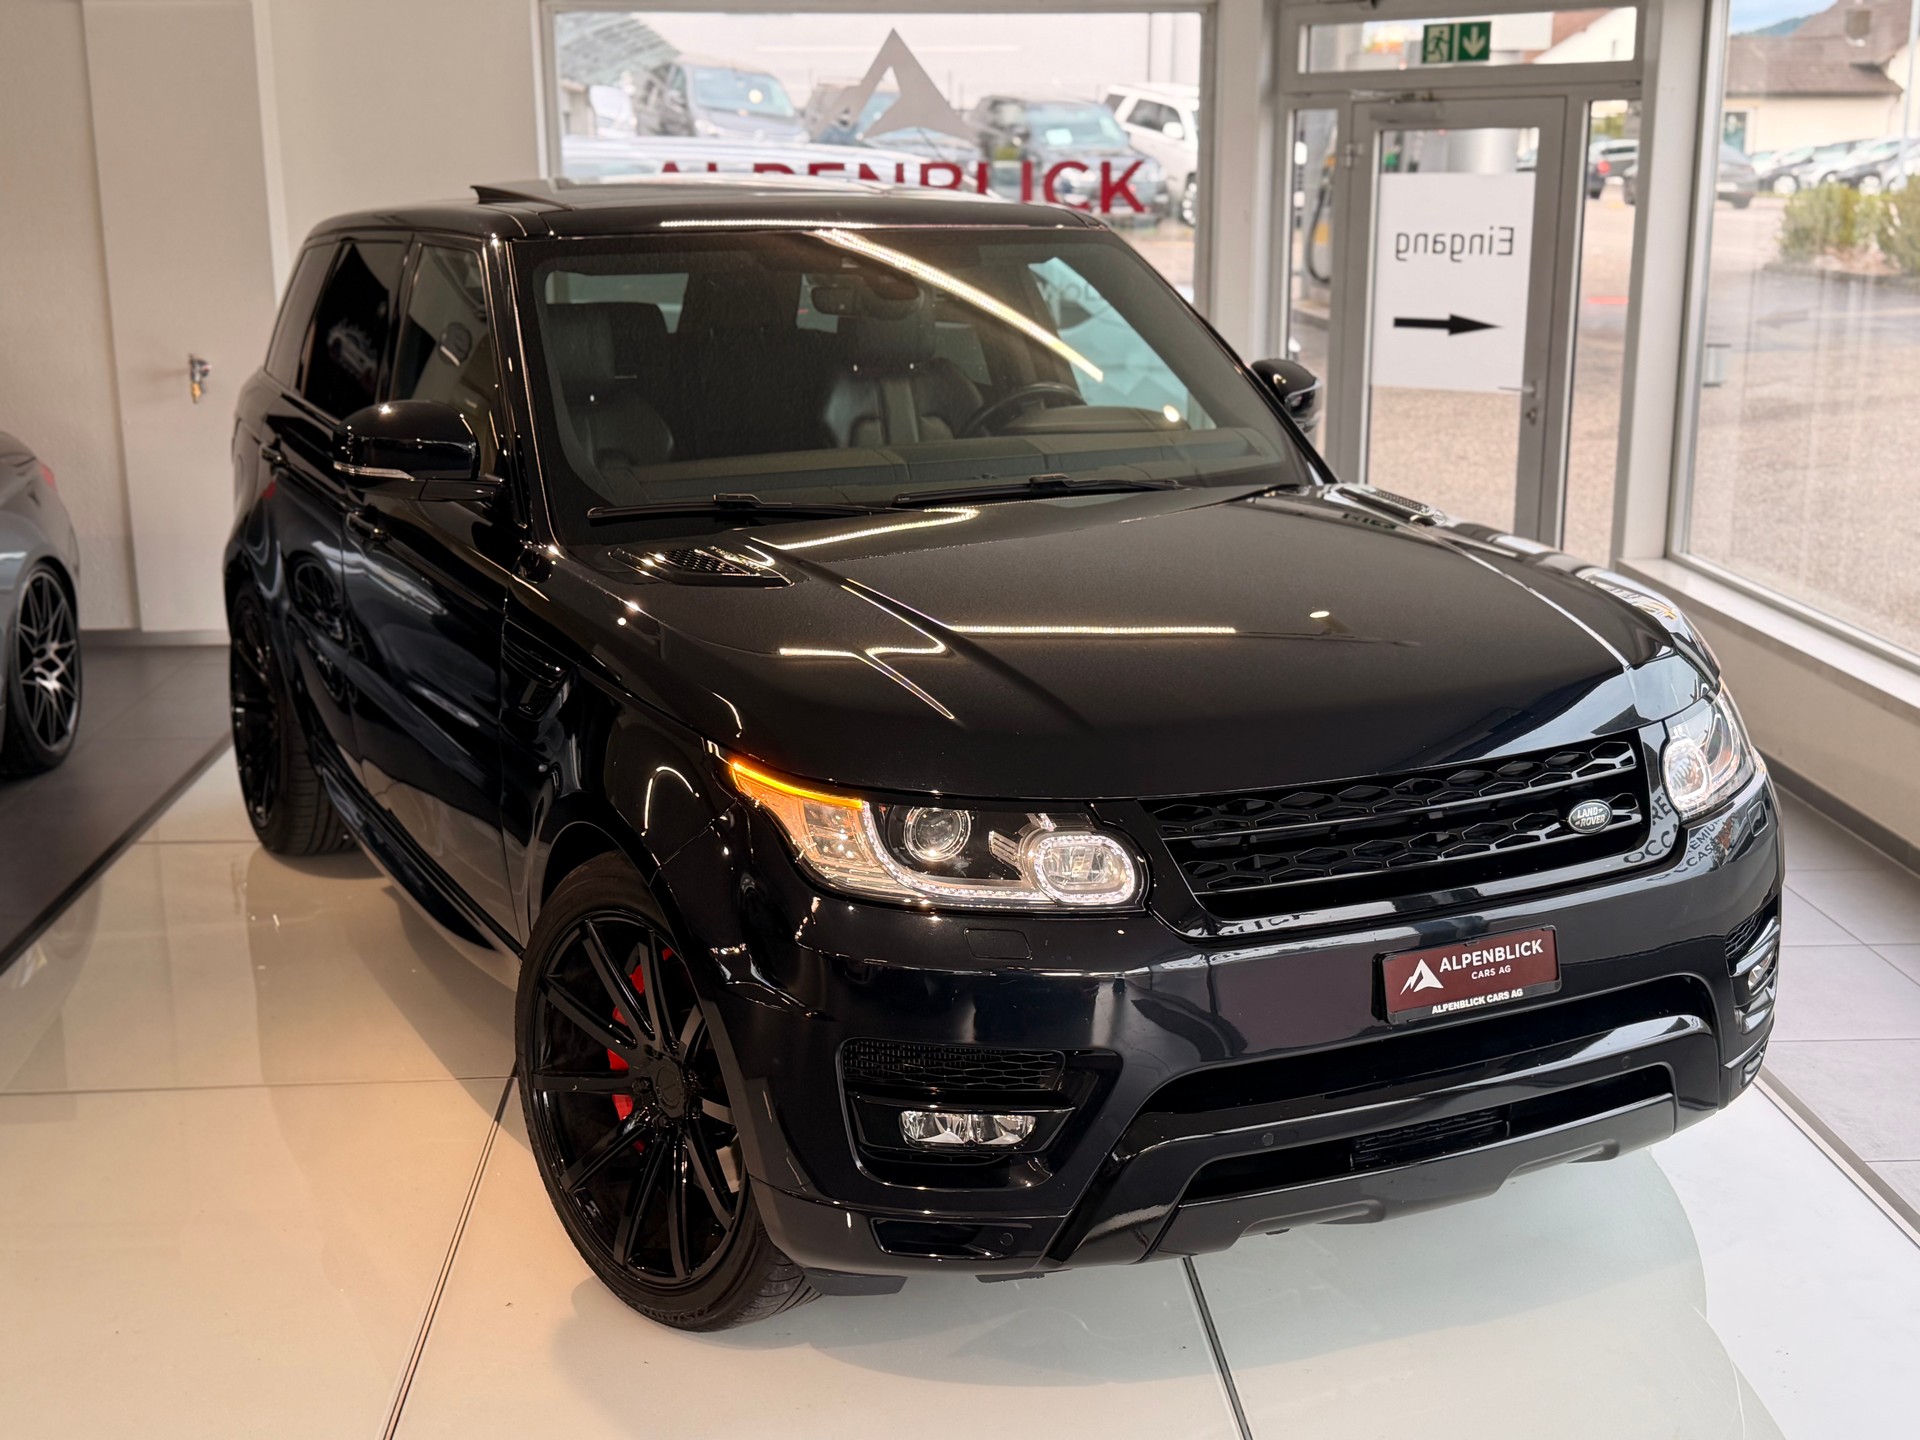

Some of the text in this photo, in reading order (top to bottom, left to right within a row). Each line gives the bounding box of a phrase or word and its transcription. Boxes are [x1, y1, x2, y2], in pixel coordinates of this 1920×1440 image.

[1577, 806, 1598, 819] LAND
[1580, 815, 1605, 827] ROVER
[1439, 939, 1544, 973] ALPENBLICK
[1471, 964, 1512, 980] CARS AG
[1431, 988, 1524, 1015] ALPENBLICK CARS AG
